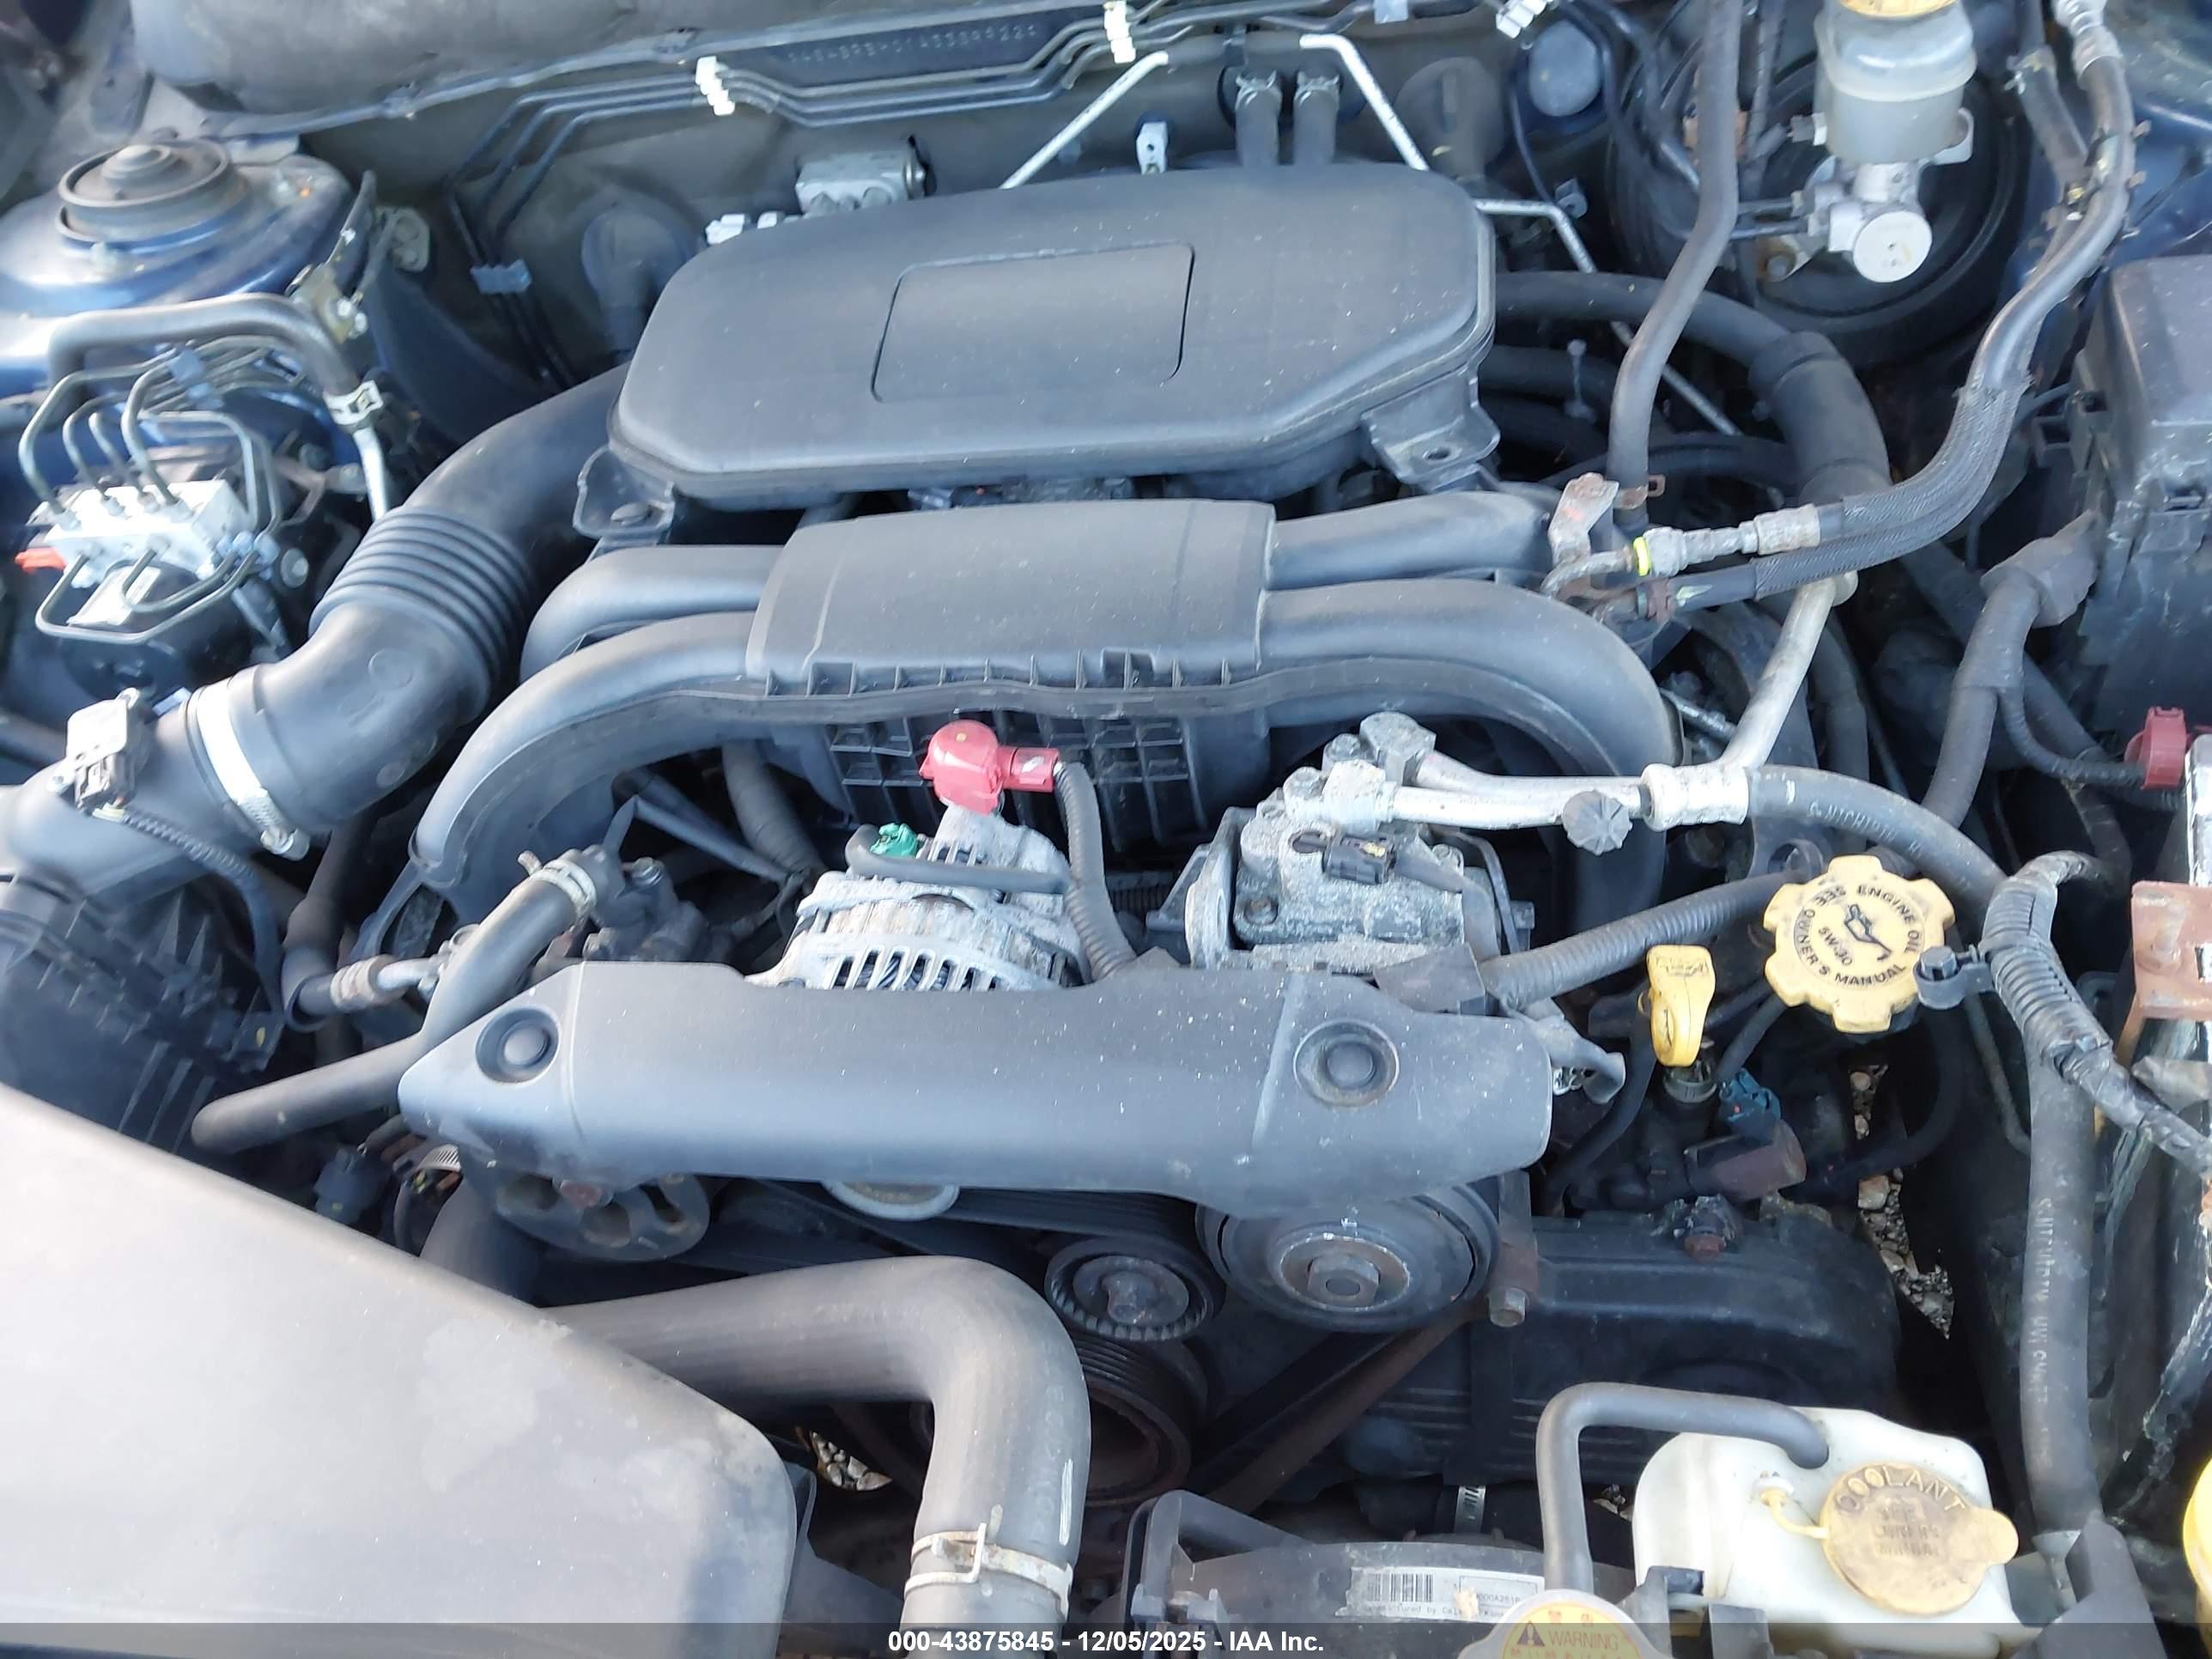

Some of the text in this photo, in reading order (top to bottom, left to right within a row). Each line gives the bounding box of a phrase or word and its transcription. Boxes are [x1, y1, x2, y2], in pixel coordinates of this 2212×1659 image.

[1798, 885, 1906, 986] SEE OWNER'S MANUAL
[1856, 885, 1920, 954] ENGINE OIL
[1836, 1465, 1966, 1511] COOLANT
[1548, 1630, 1619, 1650] WARNING
